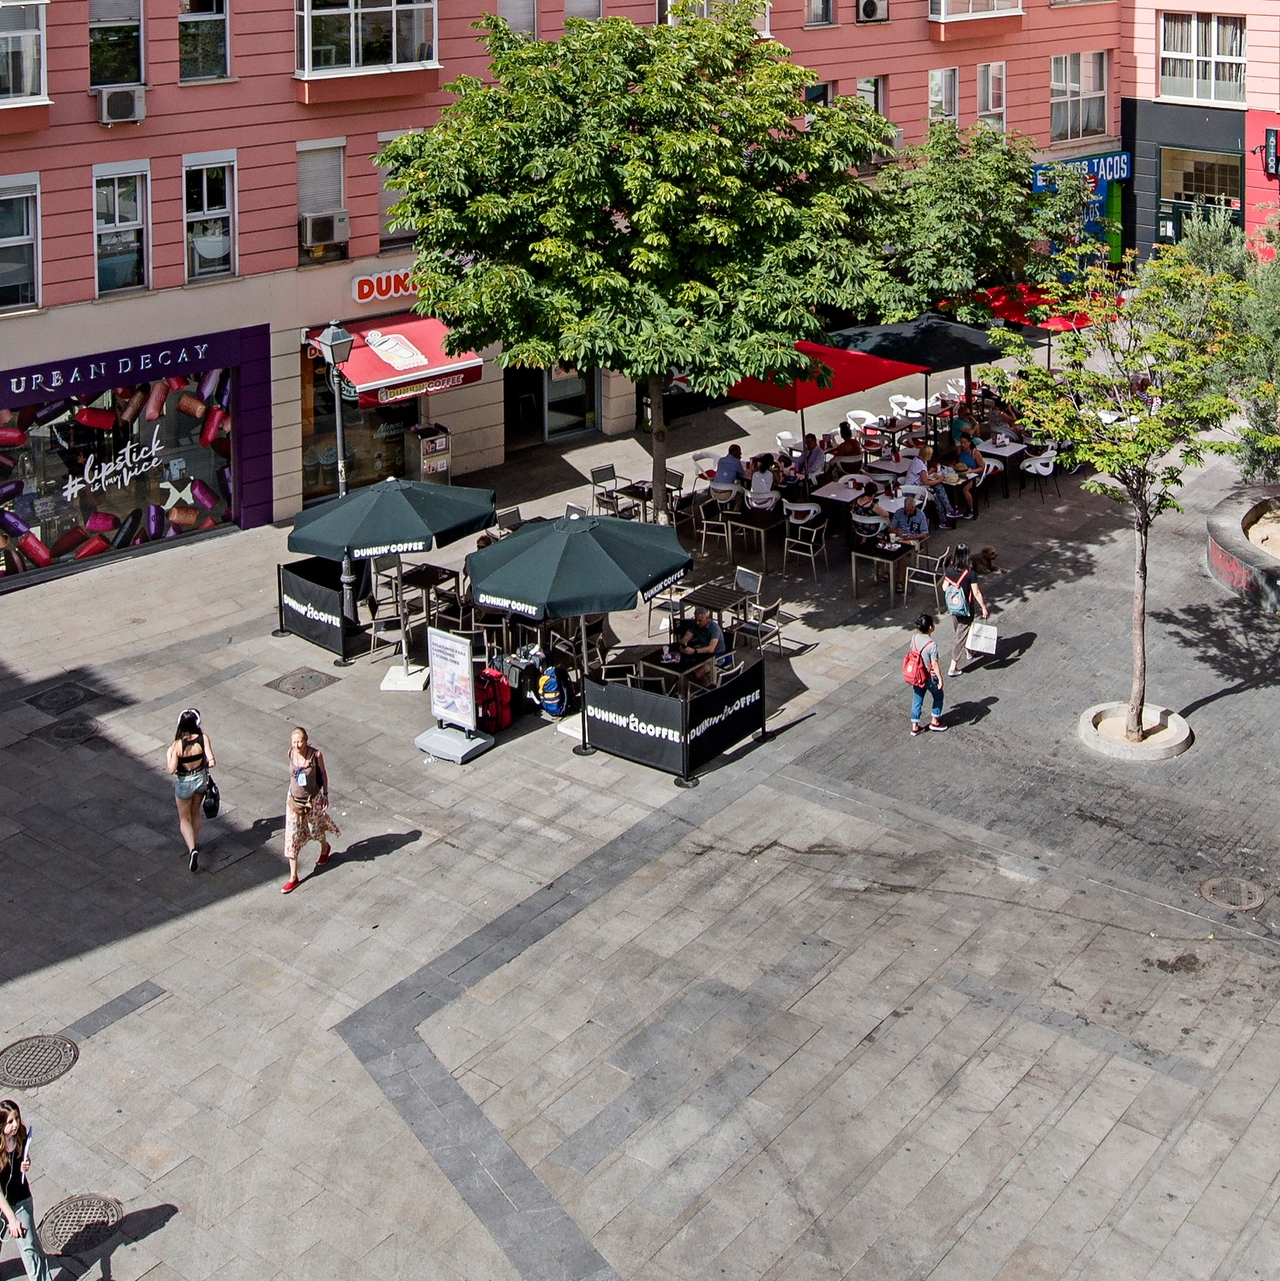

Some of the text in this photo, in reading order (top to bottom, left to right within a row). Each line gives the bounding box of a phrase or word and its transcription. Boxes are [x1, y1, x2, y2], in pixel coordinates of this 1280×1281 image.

[1092, 154, 1128, 181] TACOS
[10, 343, 209, 394] URBAN DECAY
[388, 374, 463, 399] DUNKIN' COFFEE
[354, 541, 424, 558] DUNKIN' COFFEE
[644, 569, 685, 601] DUNKIN' COFFEE
[283, 593, 340, 628] DUNKIN' COFFEE
[479, 593, 538, 616] DUNKIN' COFFEE
[587, 705, 680, 743] DUNKIN' COFFEE
[690, 689, 761, 740] DUNKIN' COFFEE
